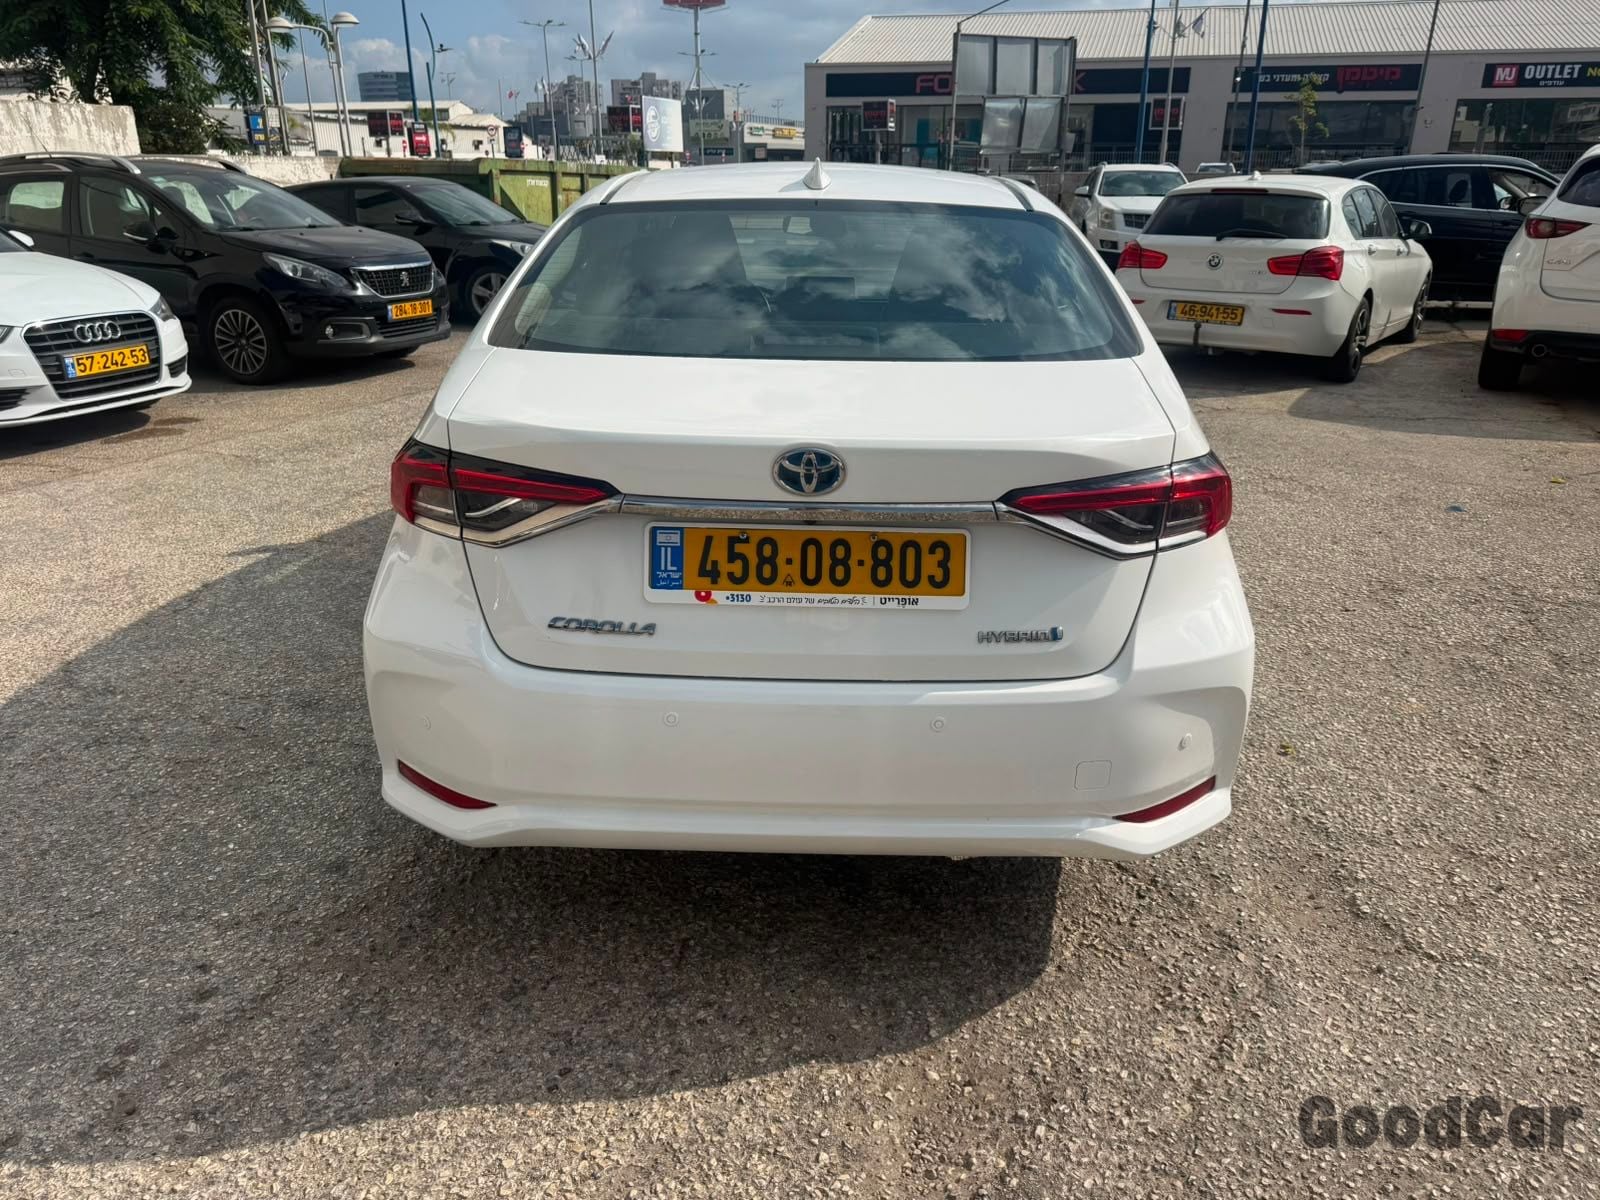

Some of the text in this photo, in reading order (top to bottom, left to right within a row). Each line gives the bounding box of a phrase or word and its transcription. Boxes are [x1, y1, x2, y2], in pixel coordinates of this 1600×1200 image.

[1496, 67, 1516, 81] MJ
[1524, 64, 1582, 79] OUTLET
[661, 547, 677, 571] IL
[547, 616, 656, 636] COROLLA
[977, 630, 1050, 644] HYBRID
